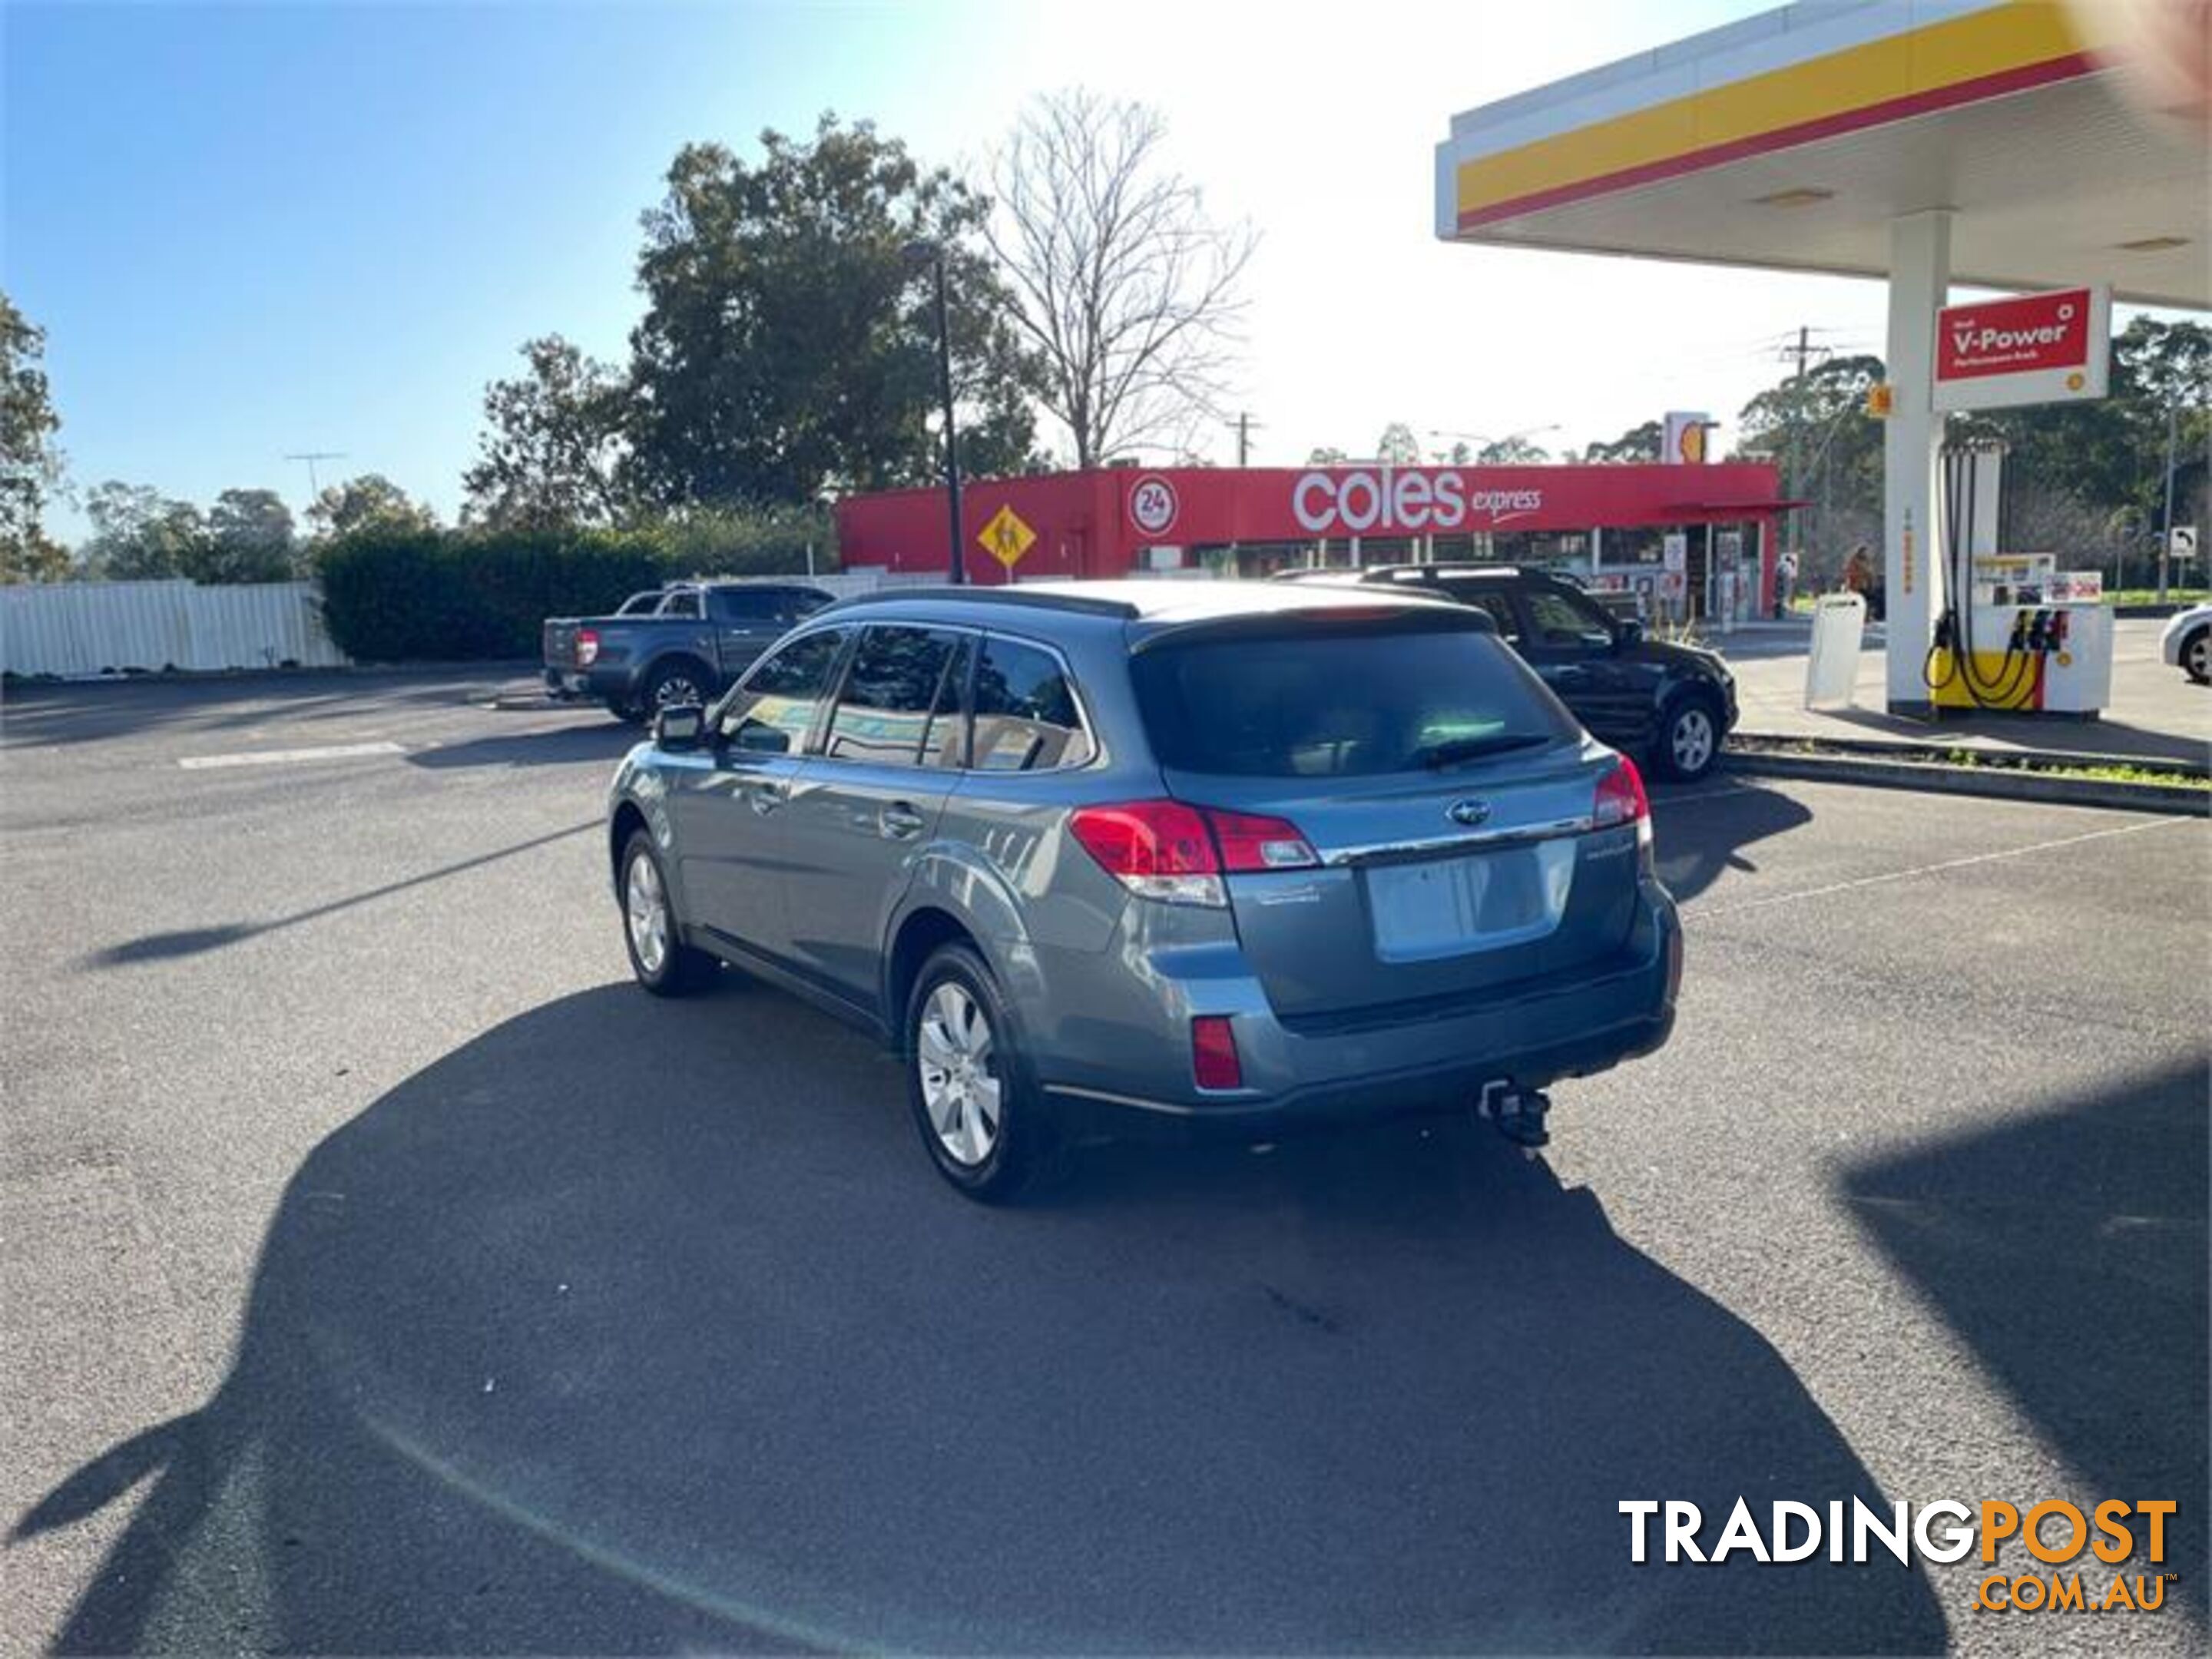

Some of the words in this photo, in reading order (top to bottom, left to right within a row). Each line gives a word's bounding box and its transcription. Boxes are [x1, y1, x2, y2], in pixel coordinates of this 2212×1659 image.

[1952, 324, 2068, 355] V-Power
[1141, 488, 1165, 512] 24
[1293, 462, 1465, 532] coles
[1472, 489, 1541, 518] express
